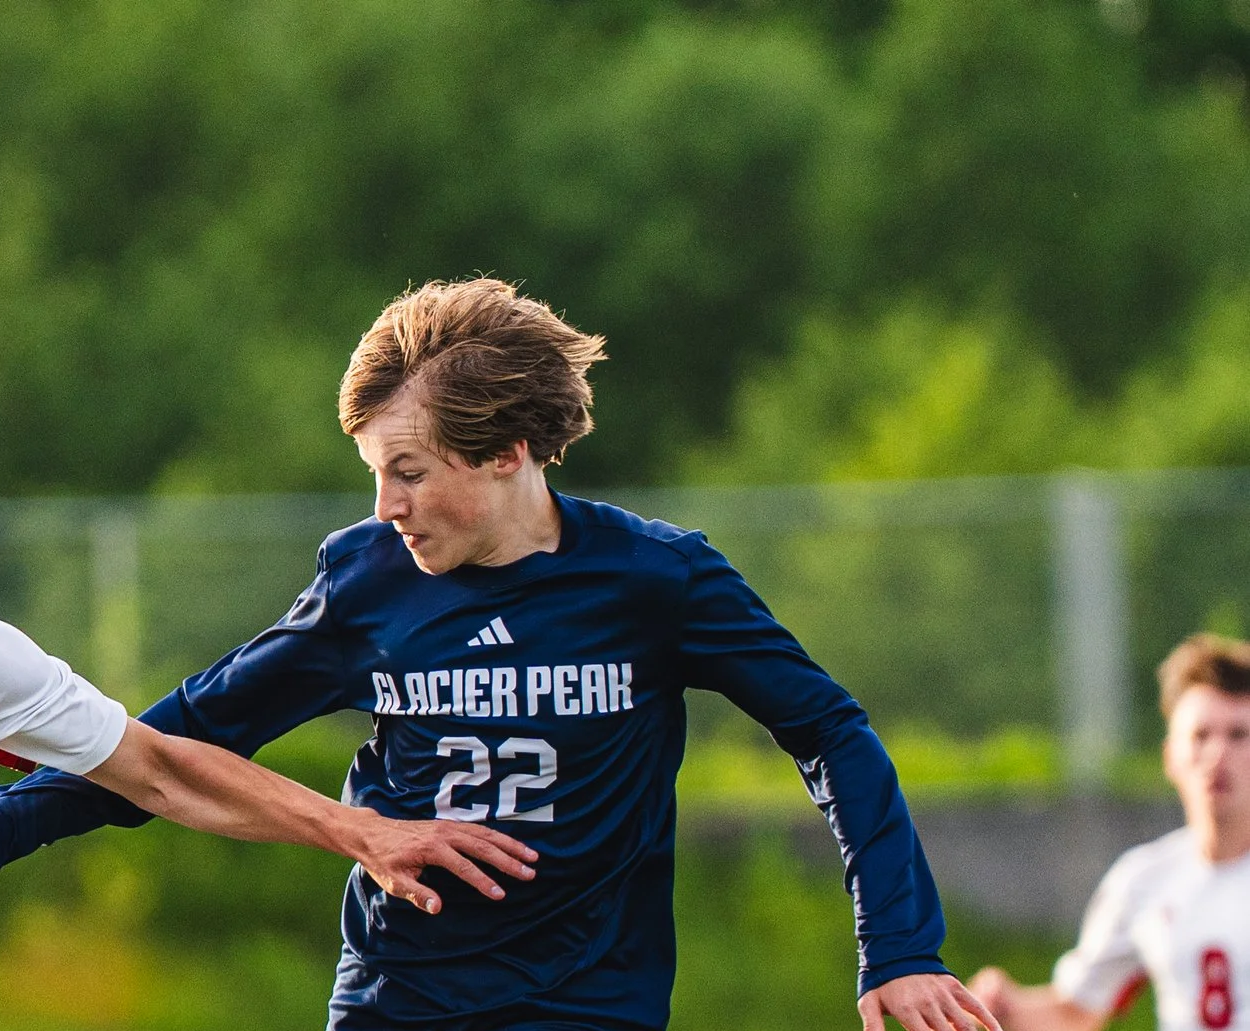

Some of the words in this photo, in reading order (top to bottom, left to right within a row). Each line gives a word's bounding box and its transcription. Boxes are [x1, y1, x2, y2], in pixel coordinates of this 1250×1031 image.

[372, 667, 518, 718] GLACIER
[526, 662, 634, 717] PEAK
[434, 735, 558, 823] 22
